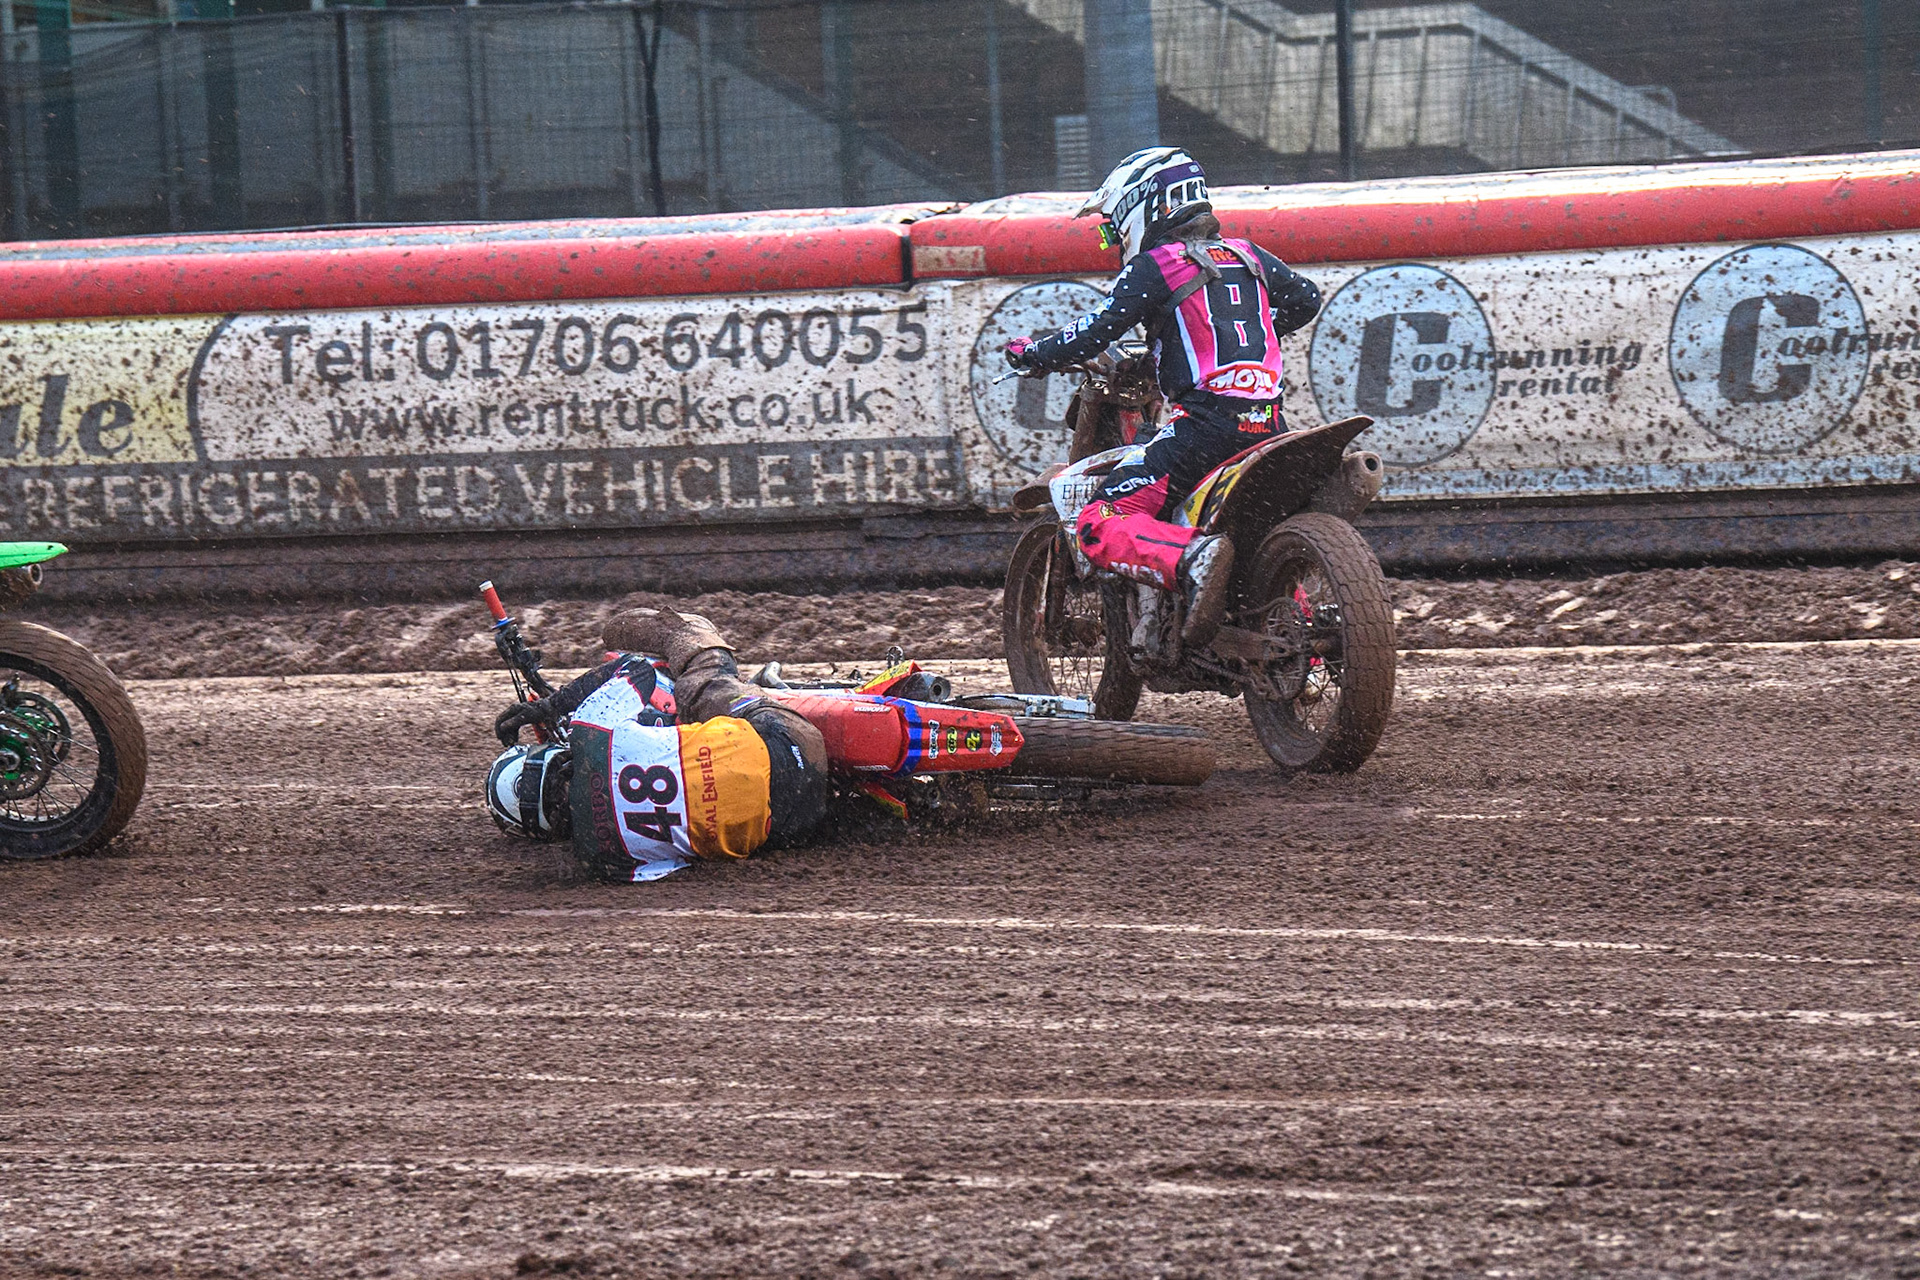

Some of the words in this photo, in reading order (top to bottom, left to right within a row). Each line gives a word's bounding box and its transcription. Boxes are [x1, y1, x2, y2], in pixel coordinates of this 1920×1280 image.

[263, 320, 395, 385] Tel:
[415, 313, 640, 381] 01706
[662, 303, 929, 372] 640055
[325, 378, 882, 441] www.rentruck.co.uk
[1499, 370, 1616, 398] rental
[23, 464, 501, 529] REFRIGERATED
[513, 454, 796, 515] VEHICLE
[810, 448, 954, 505] HIRE
[618, 763, 682, 844] 48
[698, 746, 719, 803] ENFIELD
